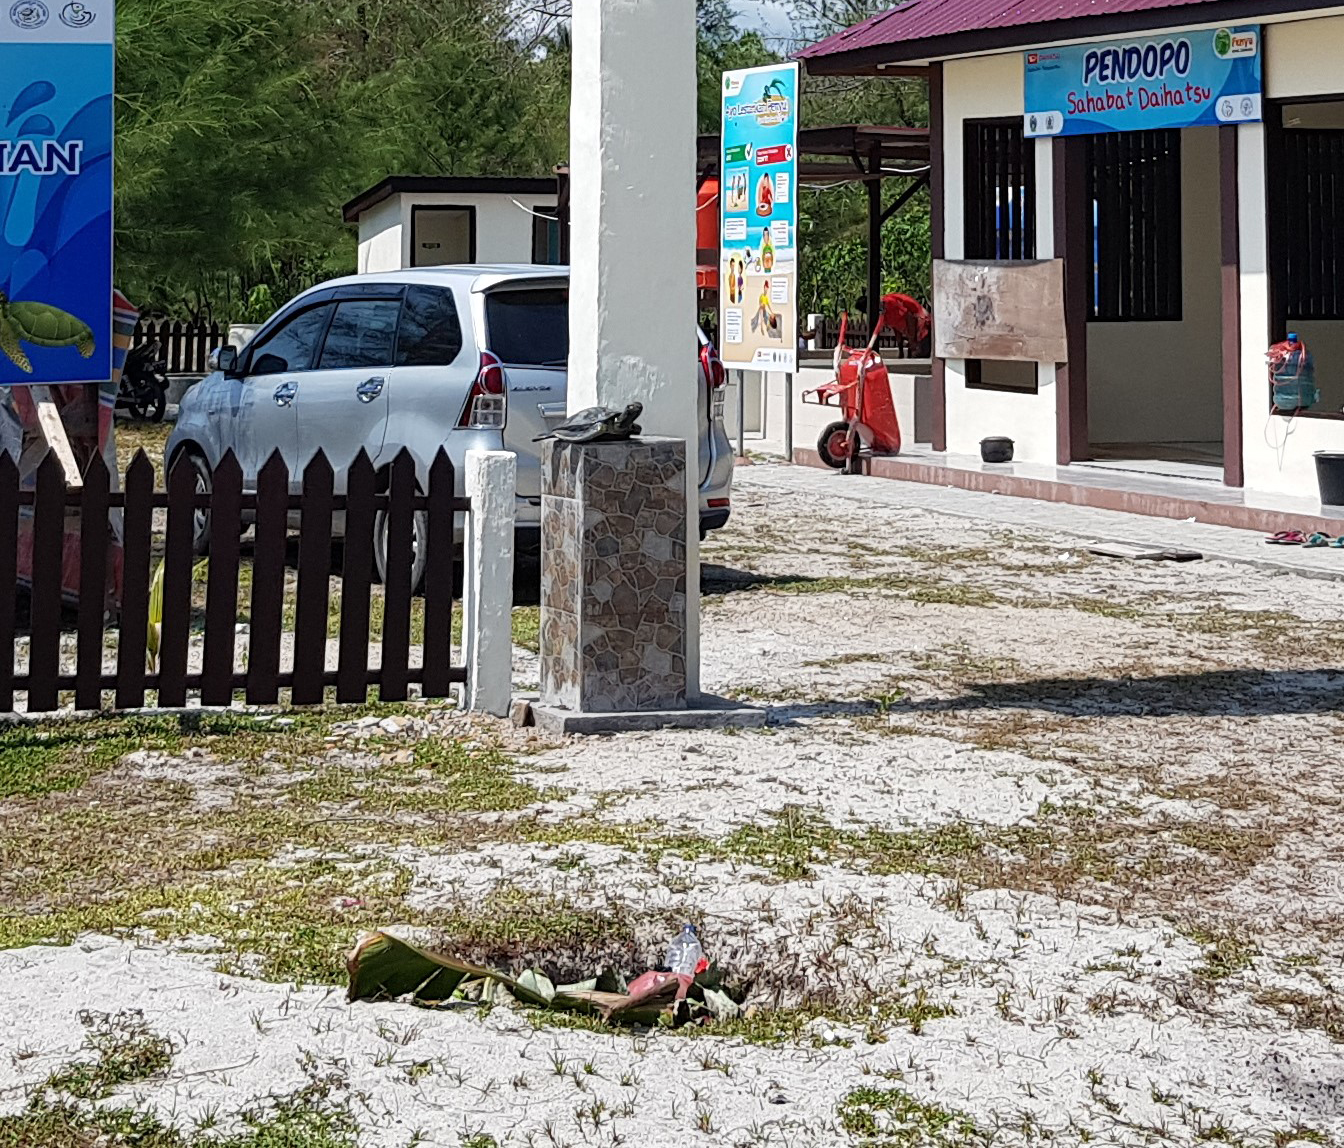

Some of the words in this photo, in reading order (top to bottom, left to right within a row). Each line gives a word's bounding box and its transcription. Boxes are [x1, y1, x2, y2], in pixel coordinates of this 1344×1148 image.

[1084, 41, 1190, 83] PENDOPO
[1067, 85, 1133, 115] Sahabat
[1138, 82, 1211, 111] Daihatsu
